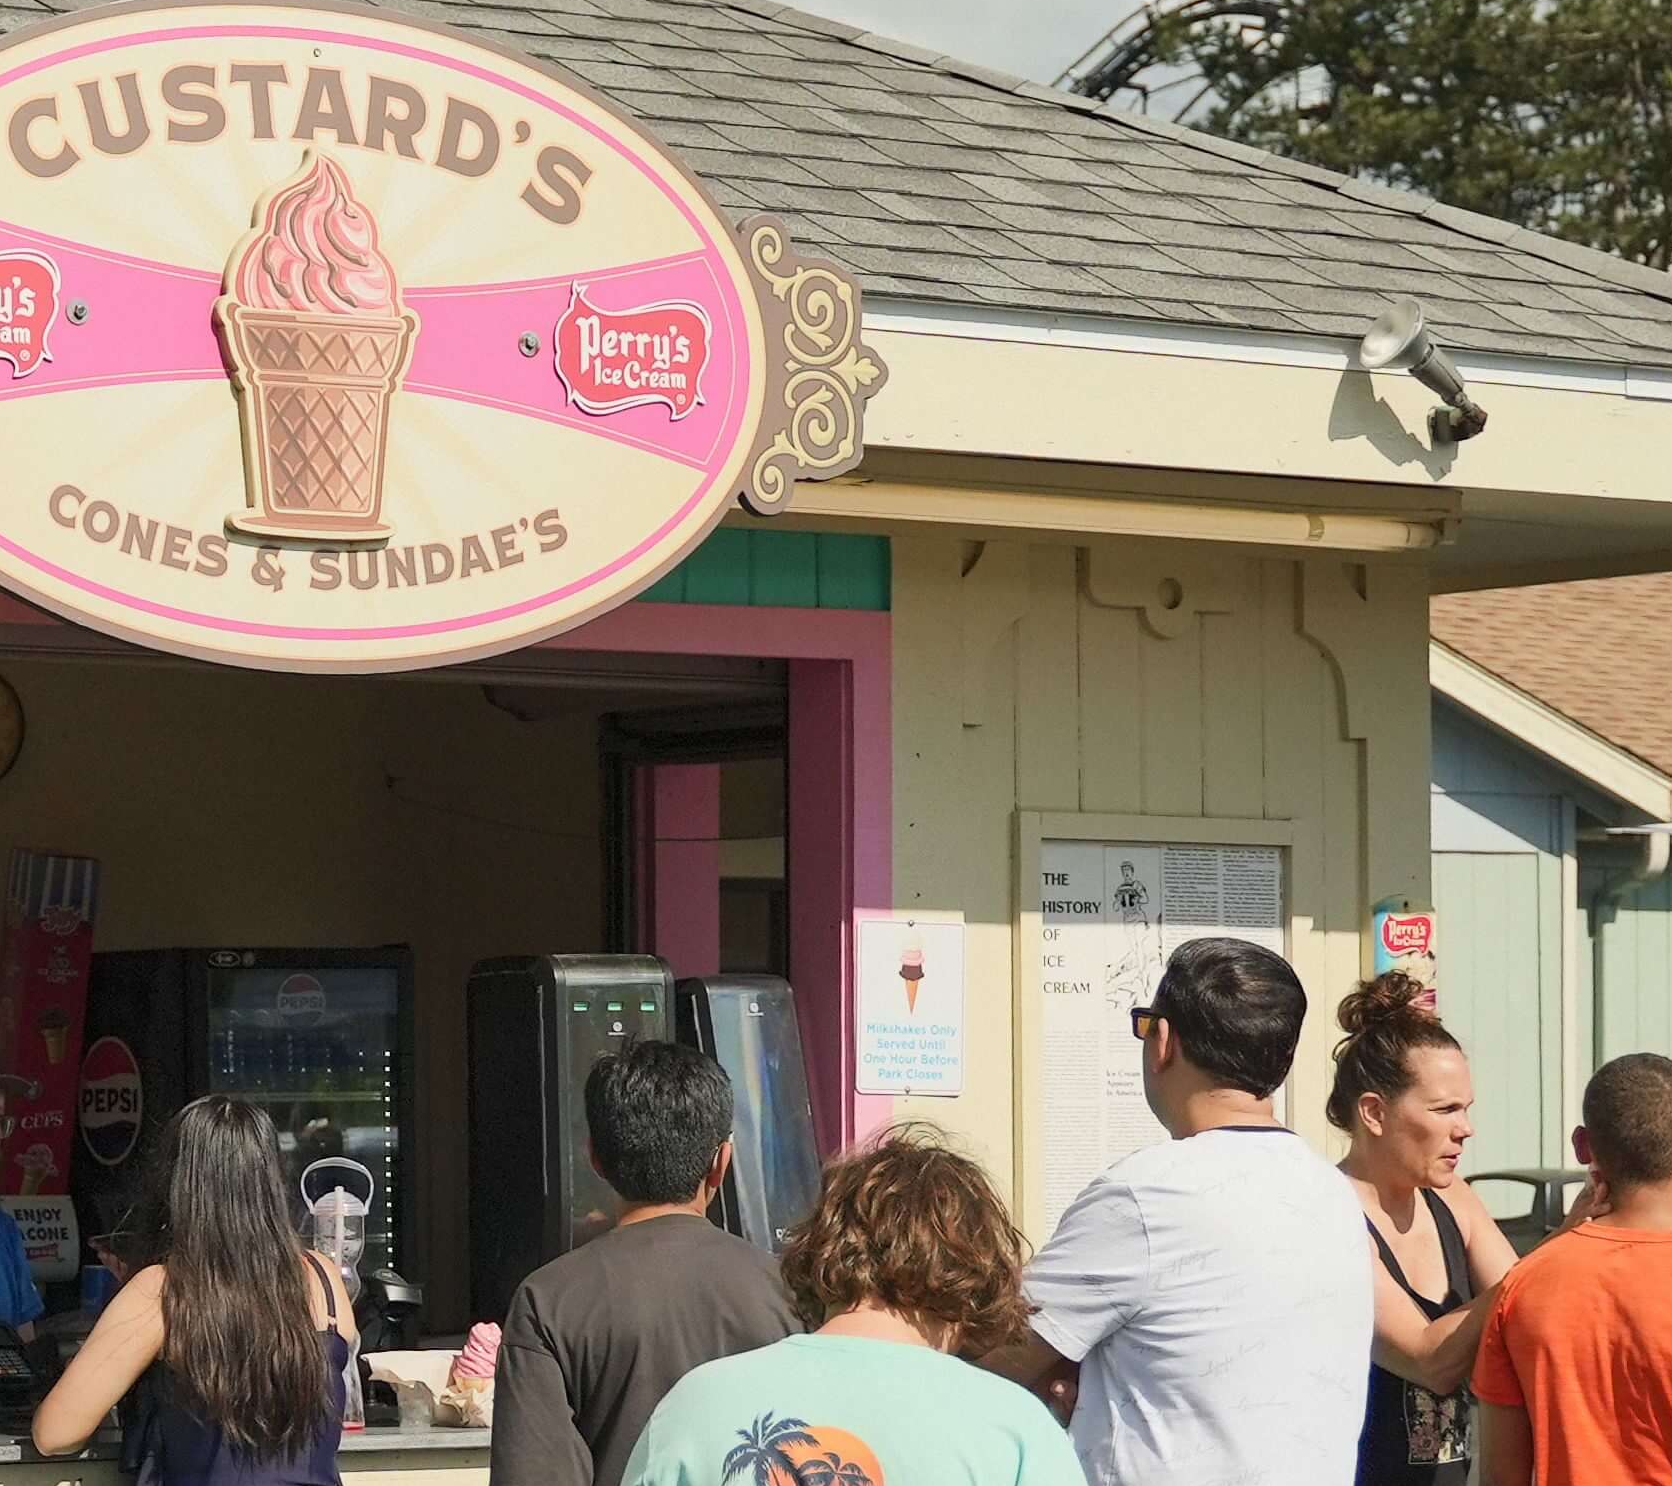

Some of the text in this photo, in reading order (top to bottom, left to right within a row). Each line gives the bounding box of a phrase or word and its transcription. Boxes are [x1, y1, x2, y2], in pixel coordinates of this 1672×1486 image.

[7, 62, 594, 225] CUSTARD'S
[575, 315, 690, 374] Perry's
[594, 358, 686, 389] Ice Cream
[48, 483, 568, 593] CONES & SUNDAE'S
[1042, 872, 1070, 886] THE
[1042, 901, 1101, 914] HISTORY
[1043, 929, 1061, 941] OF
[1388, 920, 1426, 942] Perry's
[1043, 955, 1066, 968] ICE
[1043, 982, 1091, 994] CREAM
[280, 997, 323, 1008] PEPSI
[866, 1024, 957, 1036] Milkshakes Only
[878, 1039, 946, 1049] Served Until
[863, 1054, 959, 1065] One Hour Before
[878, 1069, 942, 1079] Park Closes
[82, 1088, 138, 1114] PEPSI
[21, 1113, 63, 1129] CUPS
[14, 1209, 61, 1224] ENJOY
[27, 1227, 69, 1240] CONE
